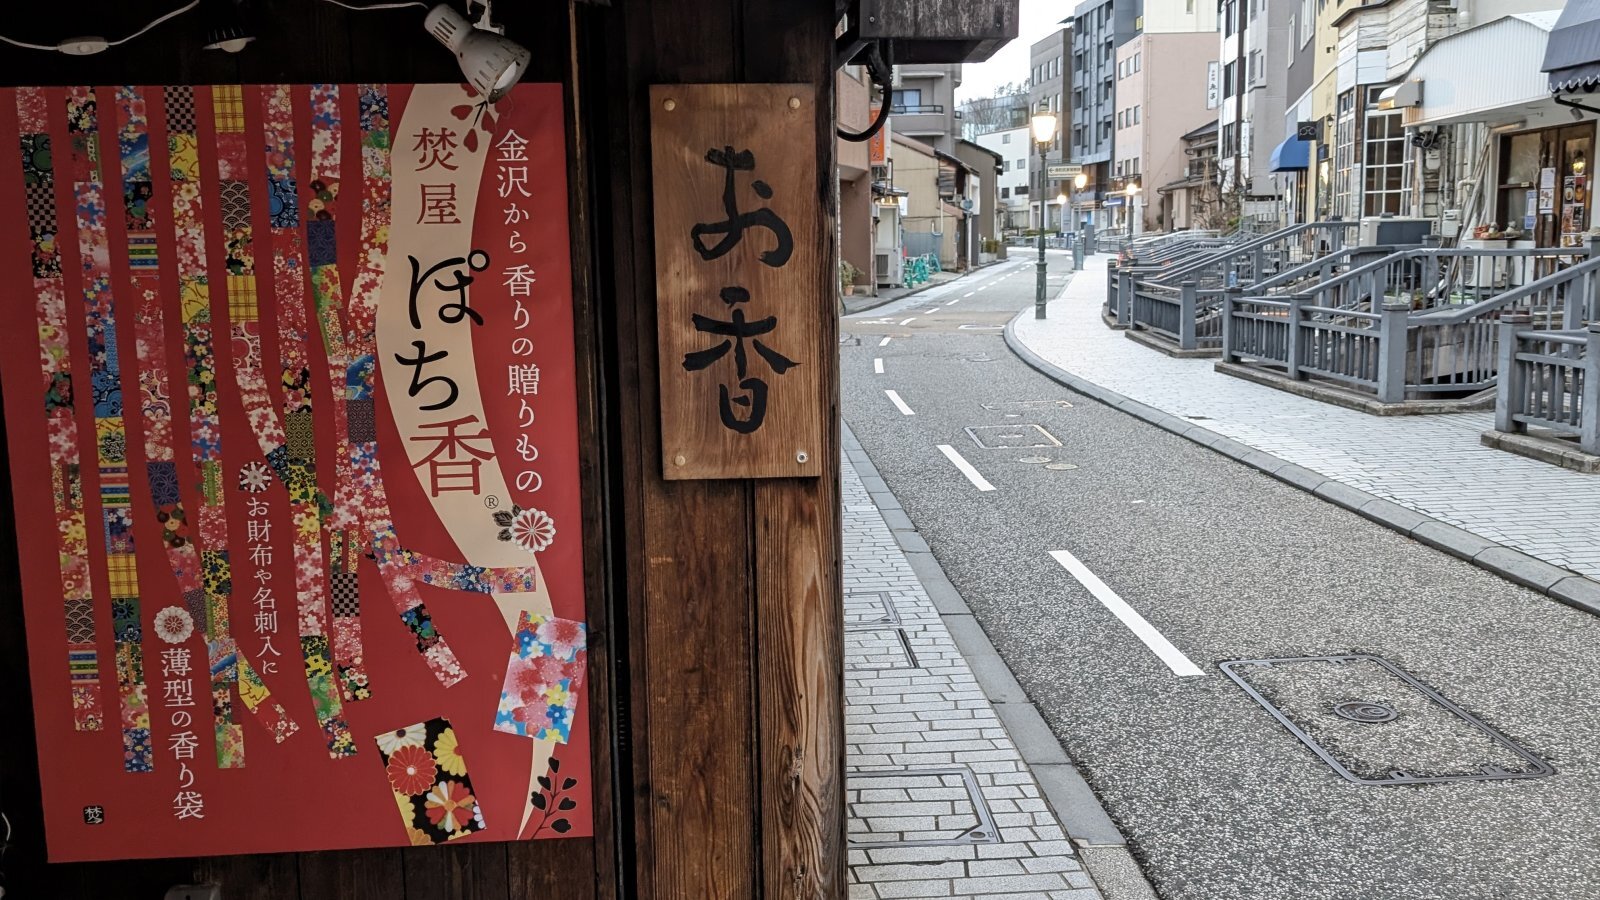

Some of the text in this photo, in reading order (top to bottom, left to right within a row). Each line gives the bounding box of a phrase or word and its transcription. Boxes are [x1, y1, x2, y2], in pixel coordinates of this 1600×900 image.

[394, 127, 497, 498] 焚屋 ぽち香
[495, 128, 543, 493] 金沢から香りの贈りもの
[681, 145, 803, 434] お香
[246, 497, 282, 675] お財布や名刺入に
[160, 648, 205, 820] 薄型の香り袋
